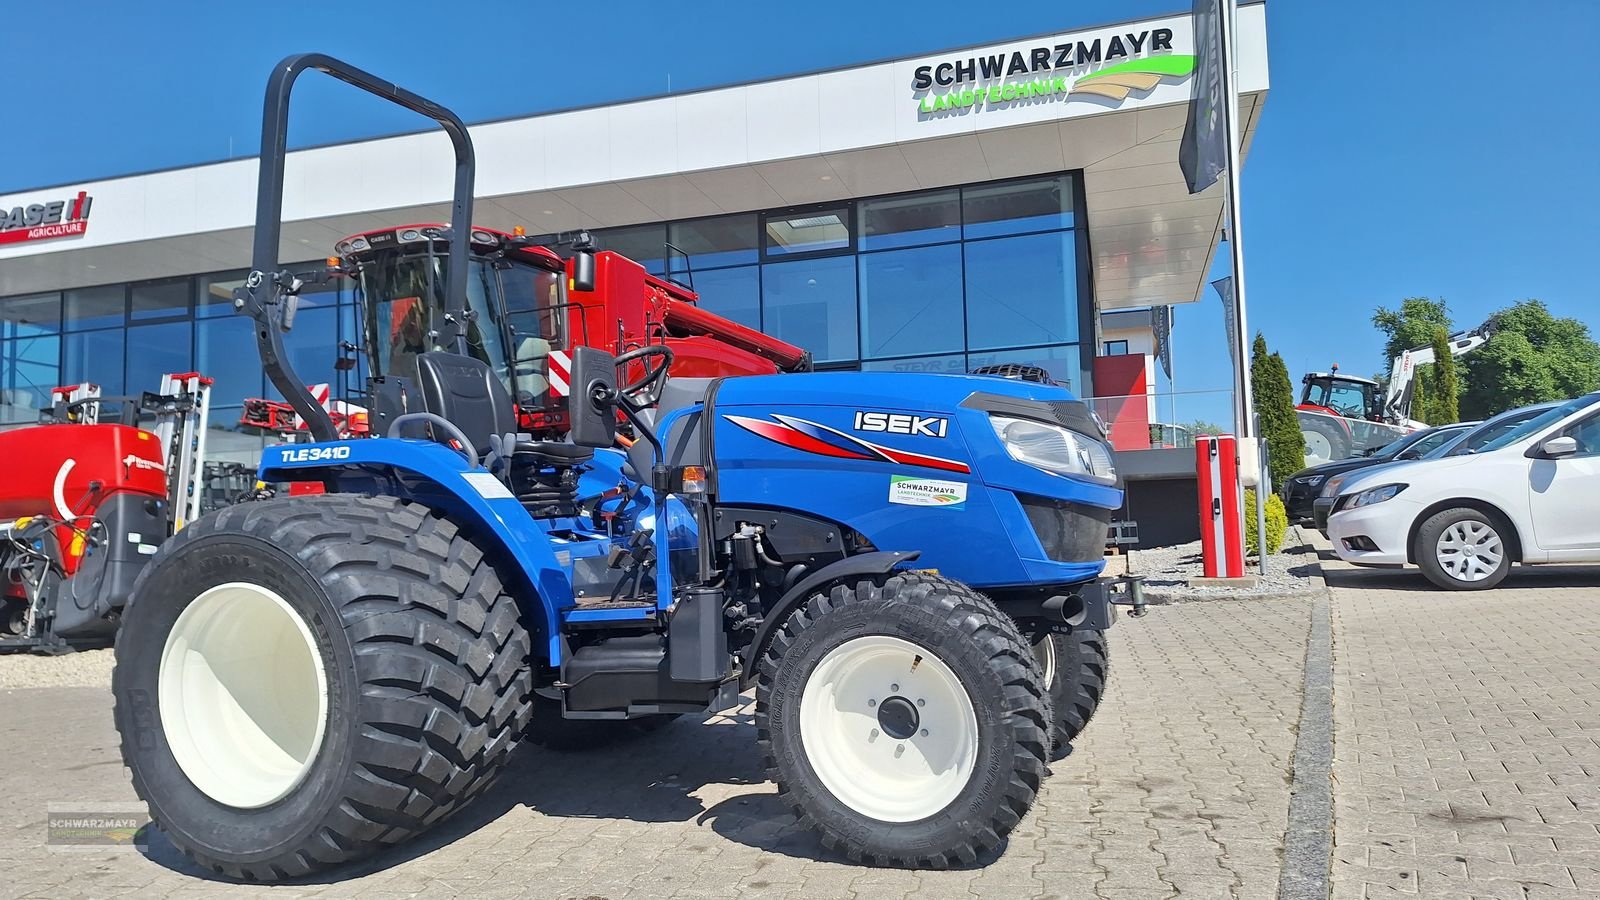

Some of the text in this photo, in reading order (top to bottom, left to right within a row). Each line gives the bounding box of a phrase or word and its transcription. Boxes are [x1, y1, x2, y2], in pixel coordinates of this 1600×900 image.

[914, 28, 1174, 89] SCHWARZMAYR
[920, 76, 1068, 113] LANDTECHNIK
[28, 223, 82, 238] AGRICULTURE
[854, 411, 949, 439] ISEKI
[281, 446, 351, 463] TLE3410
[897, 482, 956, 495] SCHWARZMAYR
[897, 490, 932, 498] LANDTECHNIK
